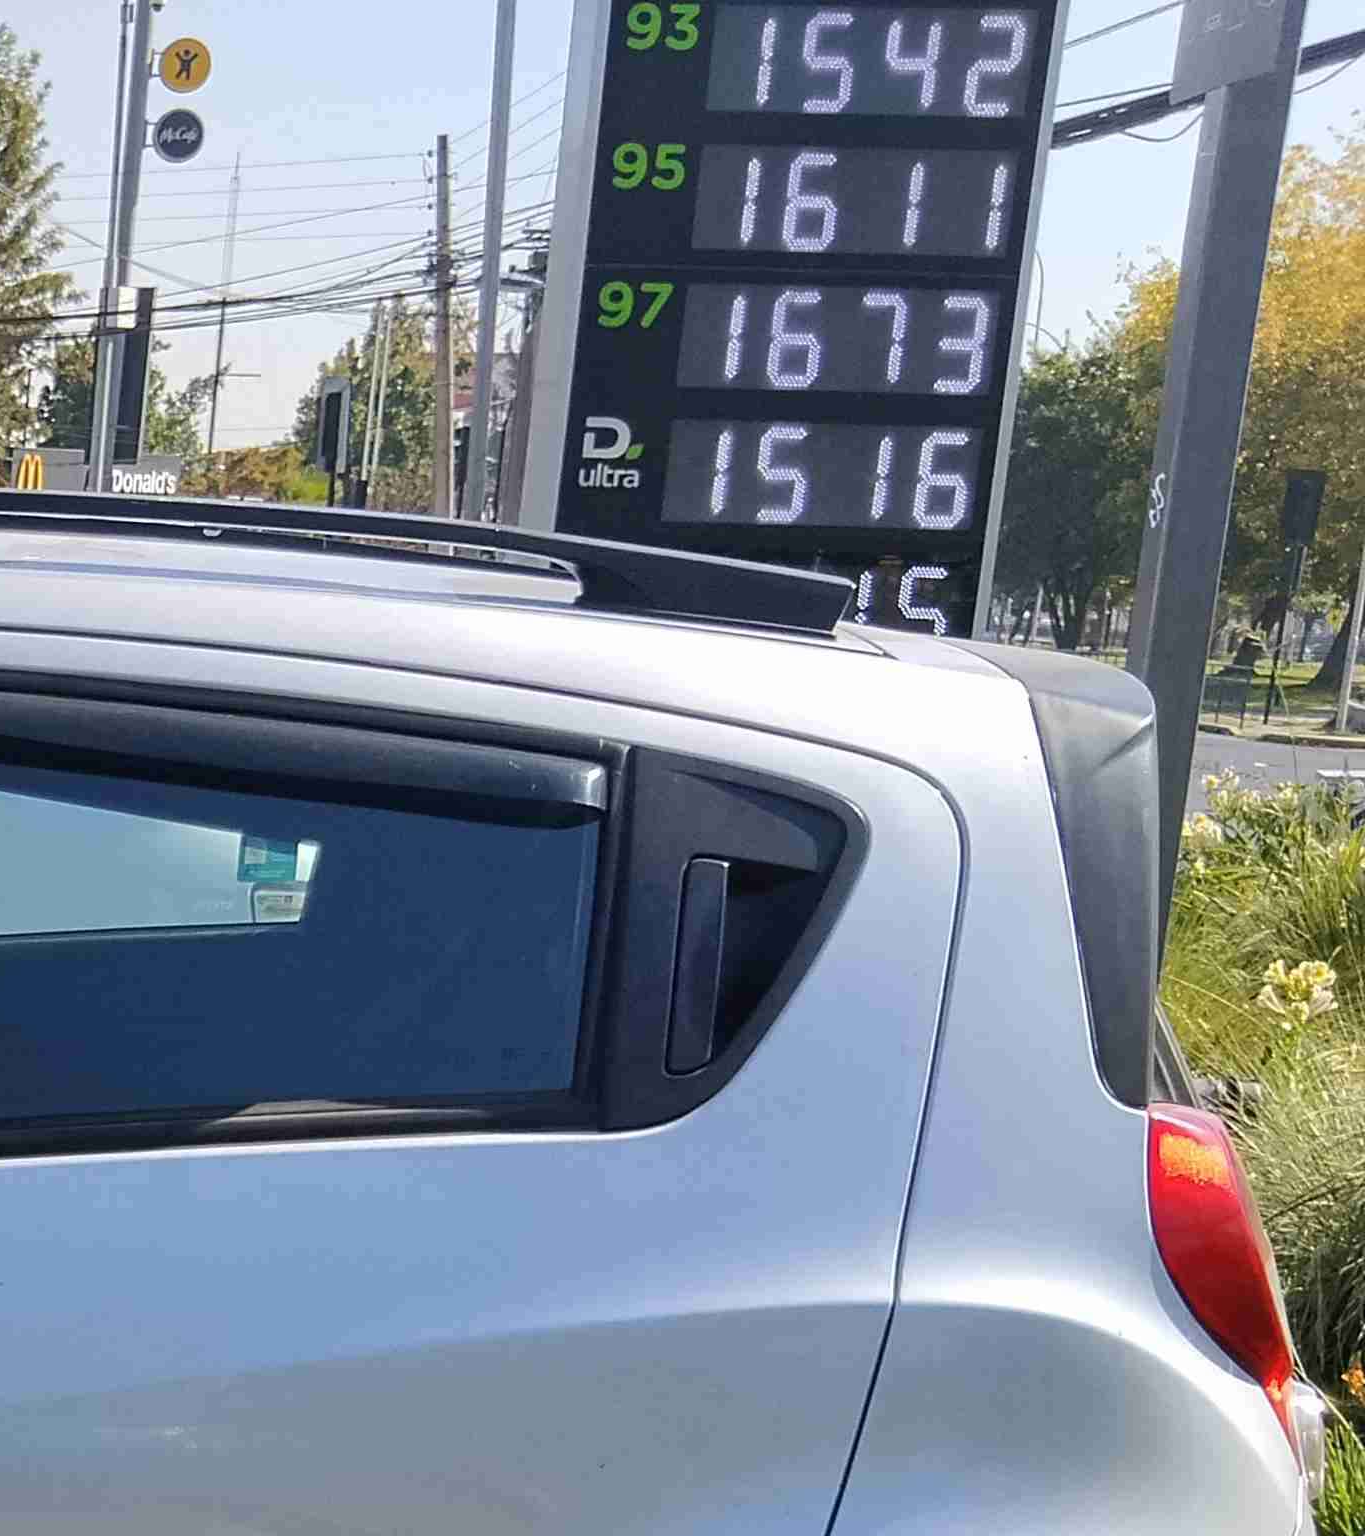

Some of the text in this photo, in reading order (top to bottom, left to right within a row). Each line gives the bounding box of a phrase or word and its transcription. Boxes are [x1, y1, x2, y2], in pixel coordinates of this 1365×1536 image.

[626, 2, 1027, 117] 93 1542
[612, 143, 1008, 251] 95 1611
[597, 281, 989, 394] 97 1673
[578, 463, 640, 488] ultra
[711, 425, 969, 529] 1516
